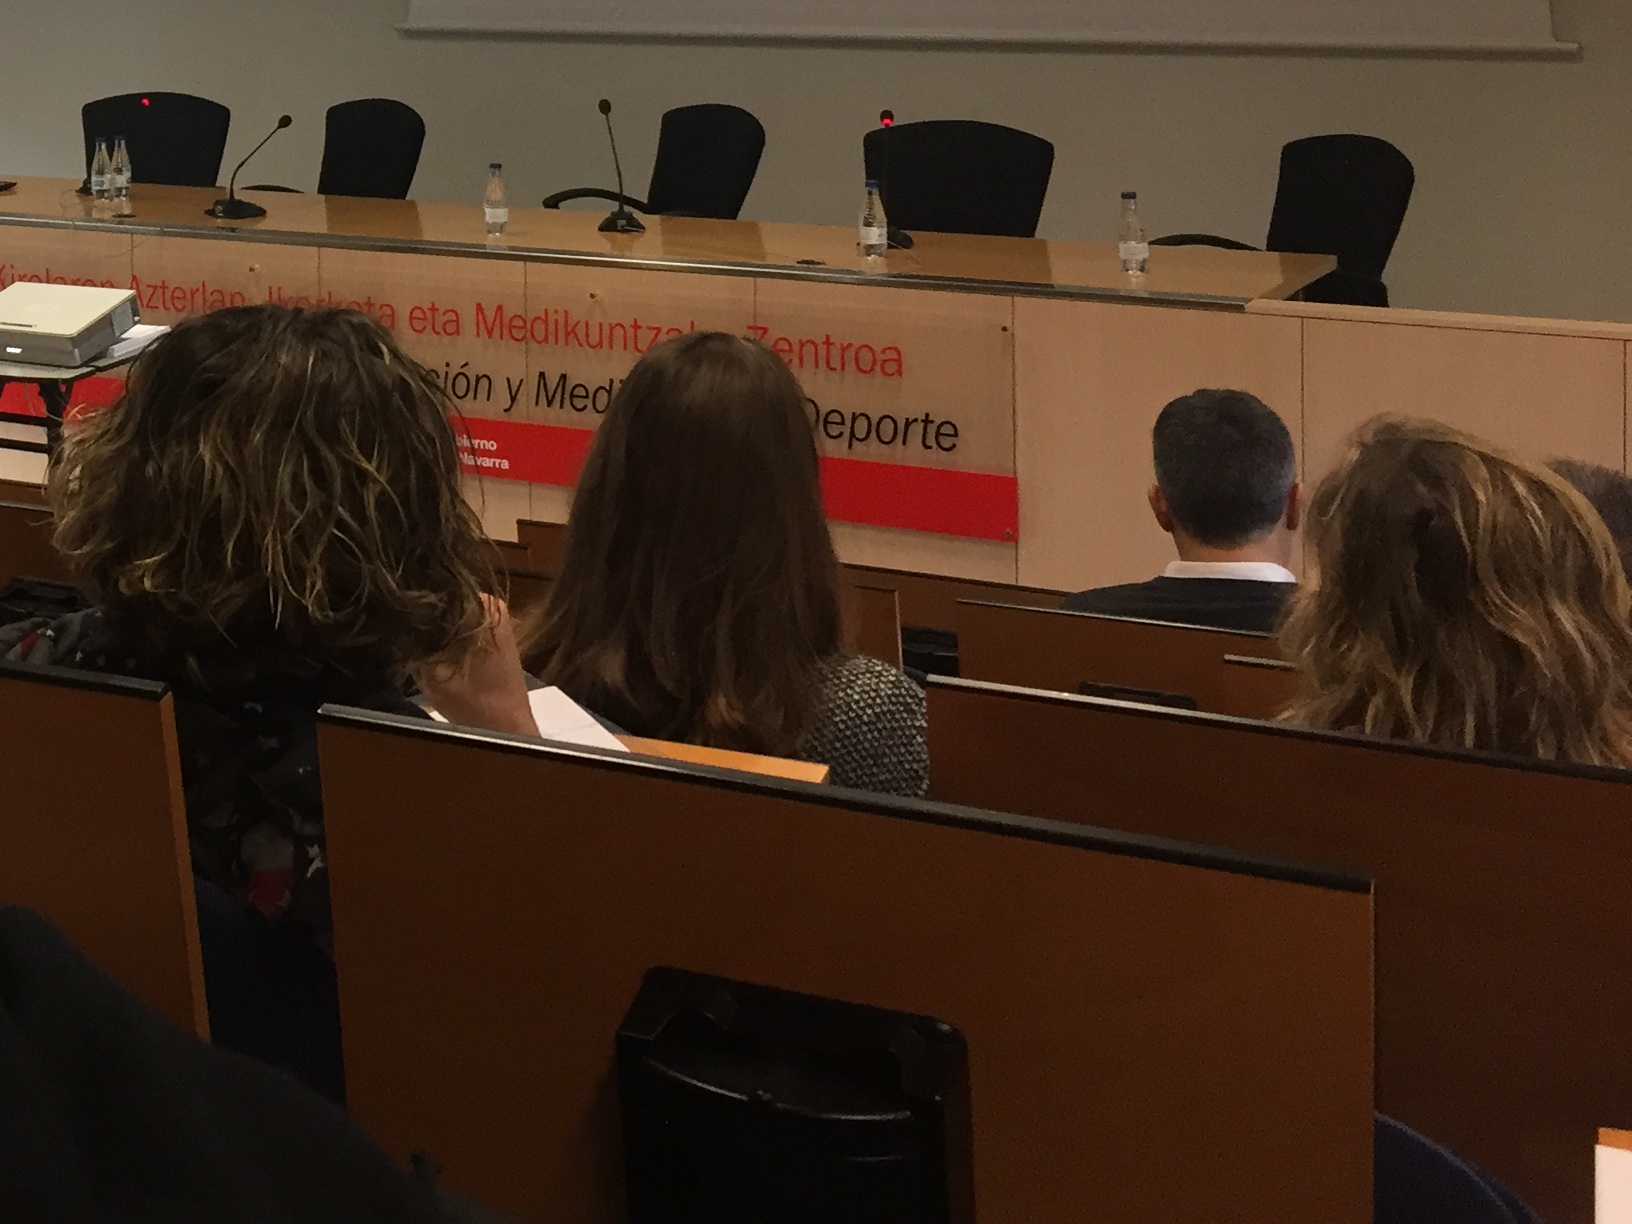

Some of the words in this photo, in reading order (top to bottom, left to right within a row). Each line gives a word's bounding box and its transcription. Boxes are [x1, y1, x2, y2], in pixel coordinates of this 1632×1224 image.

[408, 300, 461, 337] eta
[475, 302, 696, 356] Medikuntz
[503, 376, 524, 413] y
